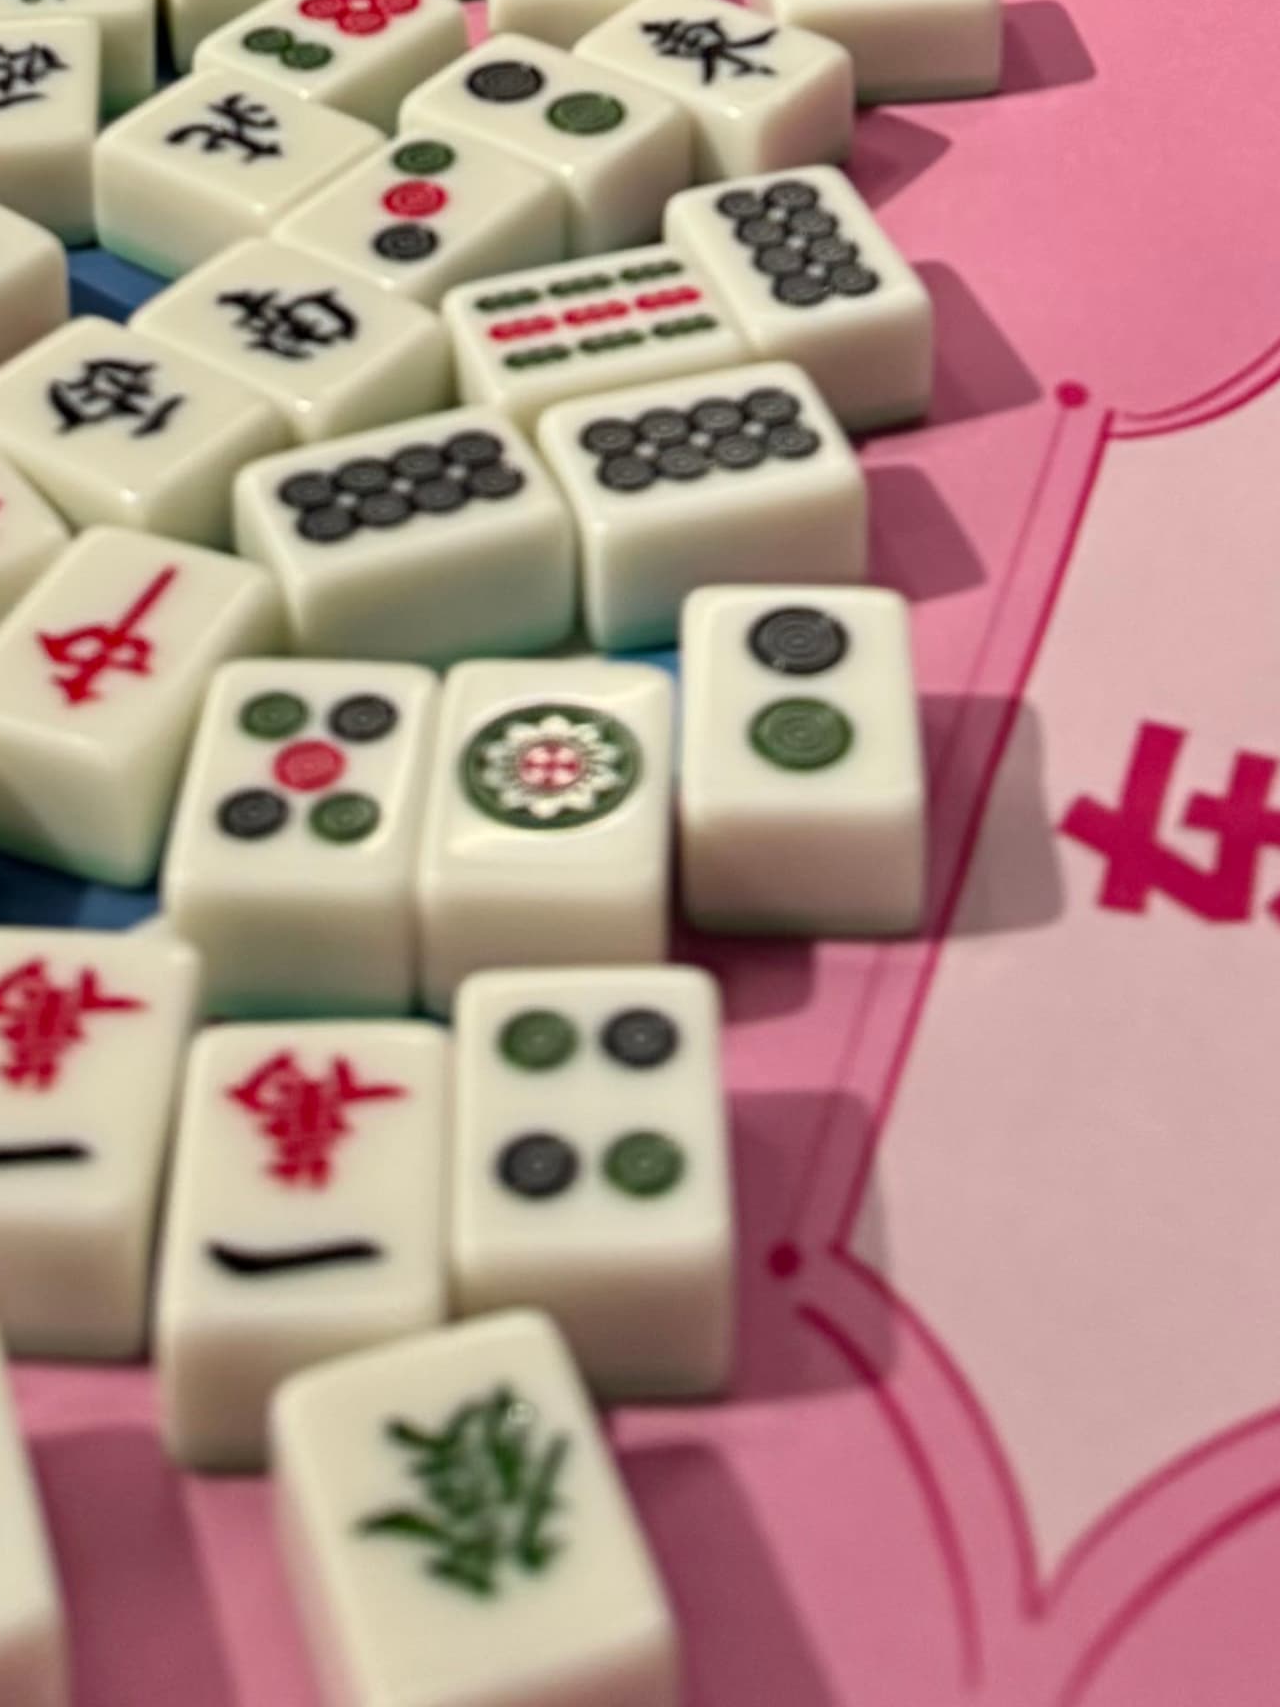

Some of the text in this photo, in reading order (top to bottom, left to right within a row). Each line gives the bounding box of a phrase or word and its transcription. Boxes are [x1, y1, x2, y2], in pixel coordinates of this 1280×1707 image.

[642, 20, 774, 83] 東
[167, 95, 280, 161] 北
[218, 291, 357, 360] 南
[48, 360, 181, 437] 西
[39, 570, 174, 705] 中
